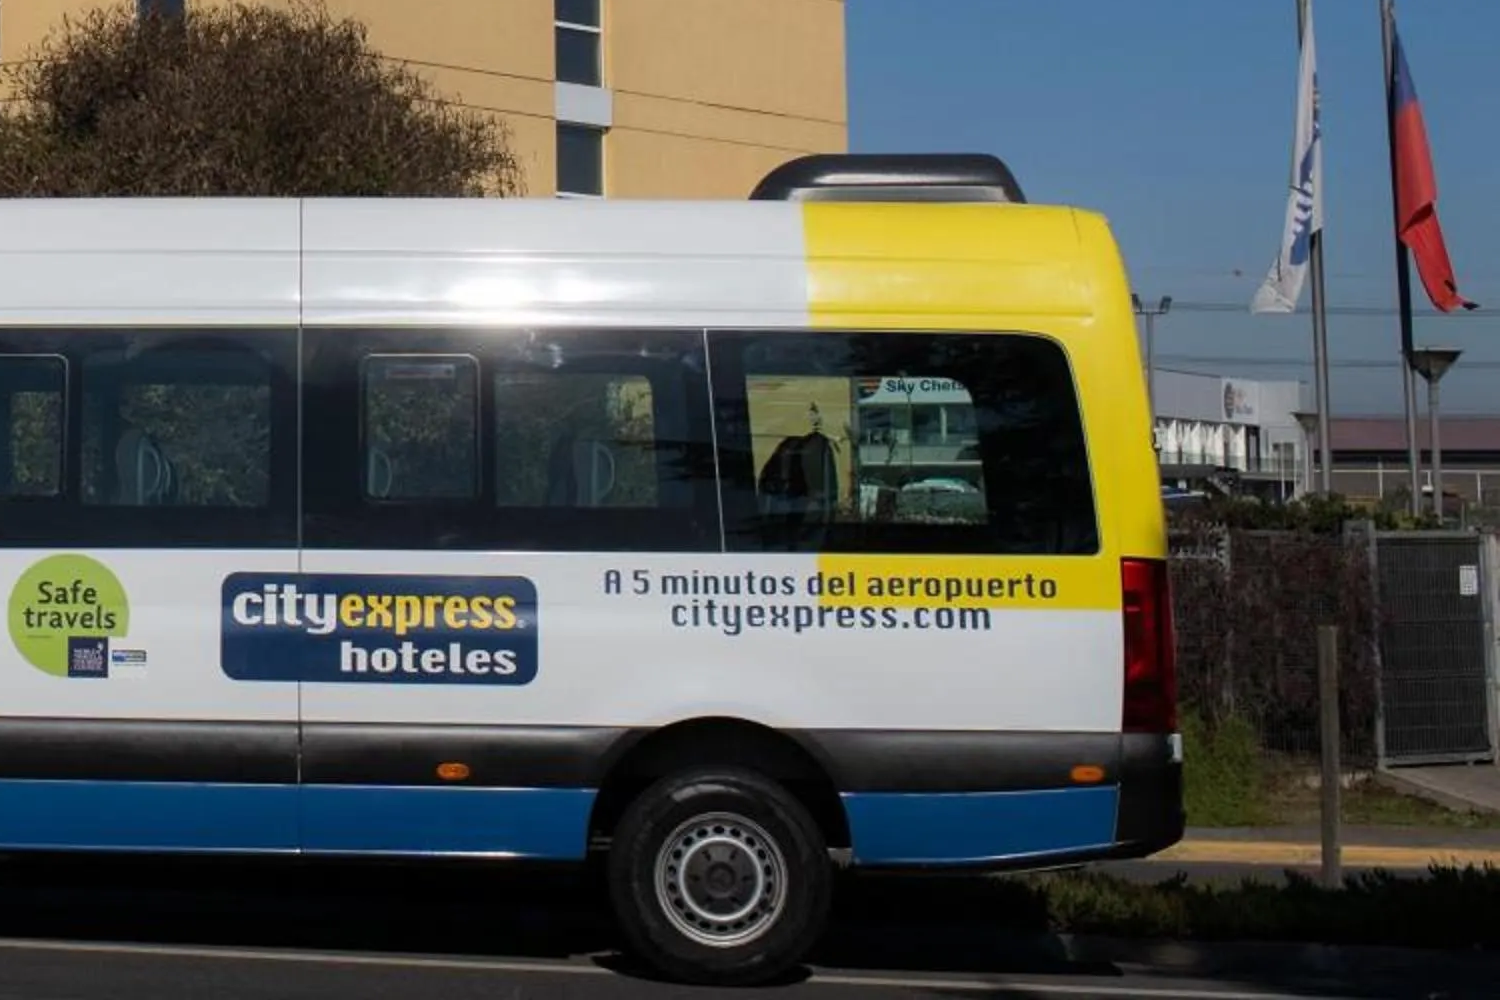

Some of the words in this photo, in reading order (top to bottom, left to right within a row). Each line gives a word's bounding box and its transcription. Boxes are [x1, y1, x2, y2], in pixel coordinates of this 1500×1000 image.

[37, 579, 98, 604] Safe
[604, 569, 621, 595] A
[633, 570, 650, 595] 5
[661, 570, 796, 596] minutos
[807, 571, 857, 597] del
[867, 573, 1058, 603] aeropuerto
[23, 604, 117, 630] travels
[671, 599, 992, 636] cityexpress.com
[340, 641, 518, 675] hoteles
